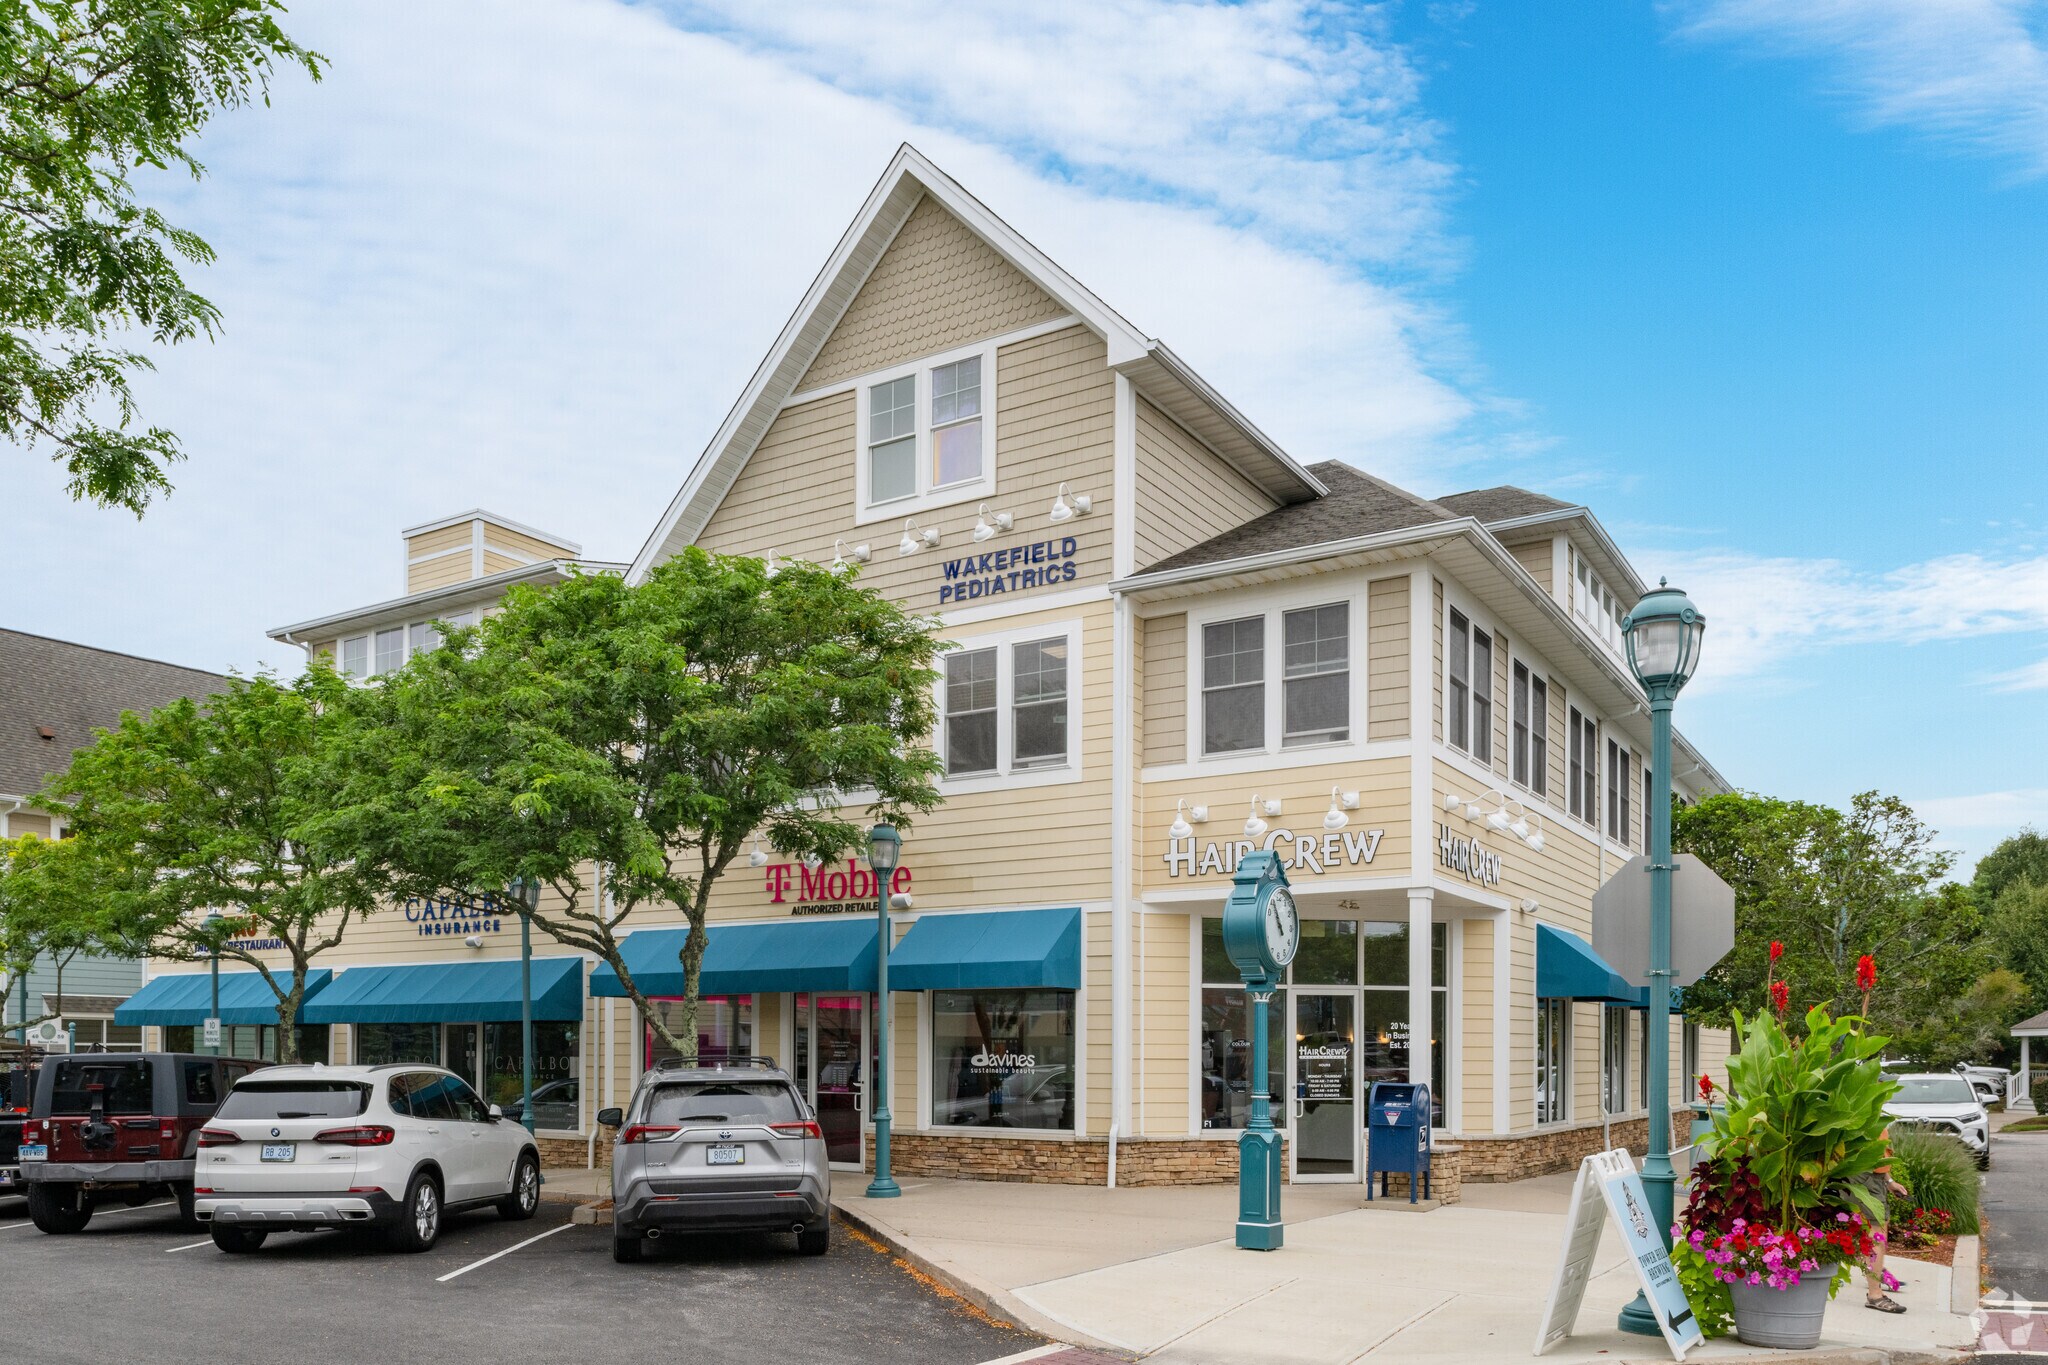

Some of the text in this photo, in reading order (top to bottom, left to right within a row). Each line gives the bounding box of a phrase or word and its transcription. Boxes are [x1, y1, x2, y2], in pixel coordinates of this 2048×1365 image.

[942, 536, 1077, 581] WAKEFIELD
[939, 560, 1077, 604] PEDIATRICS
[798, 859, 912, 902] Mobie
[405, 892, 503, 922] CAPALB
[792, 902, 879, 915] AUTHORIZED RETAILE
[419, 919, 501, 935] INSURANCE
[1390, 1022, 1410, 1030] 20 Yea
[1385, 1031, 1410, 1039] in Busin
[1390, 1041, 1402, 1049] Est.
[970, 1043, 1035, 1067] davines
[1011, 1067, 1035, 1075] beauty
[1204, 1120, 1212, 1128] F1
[265, 1147, 291, 1156] RB 205
[713, 1149, 737, 1159] 80507
